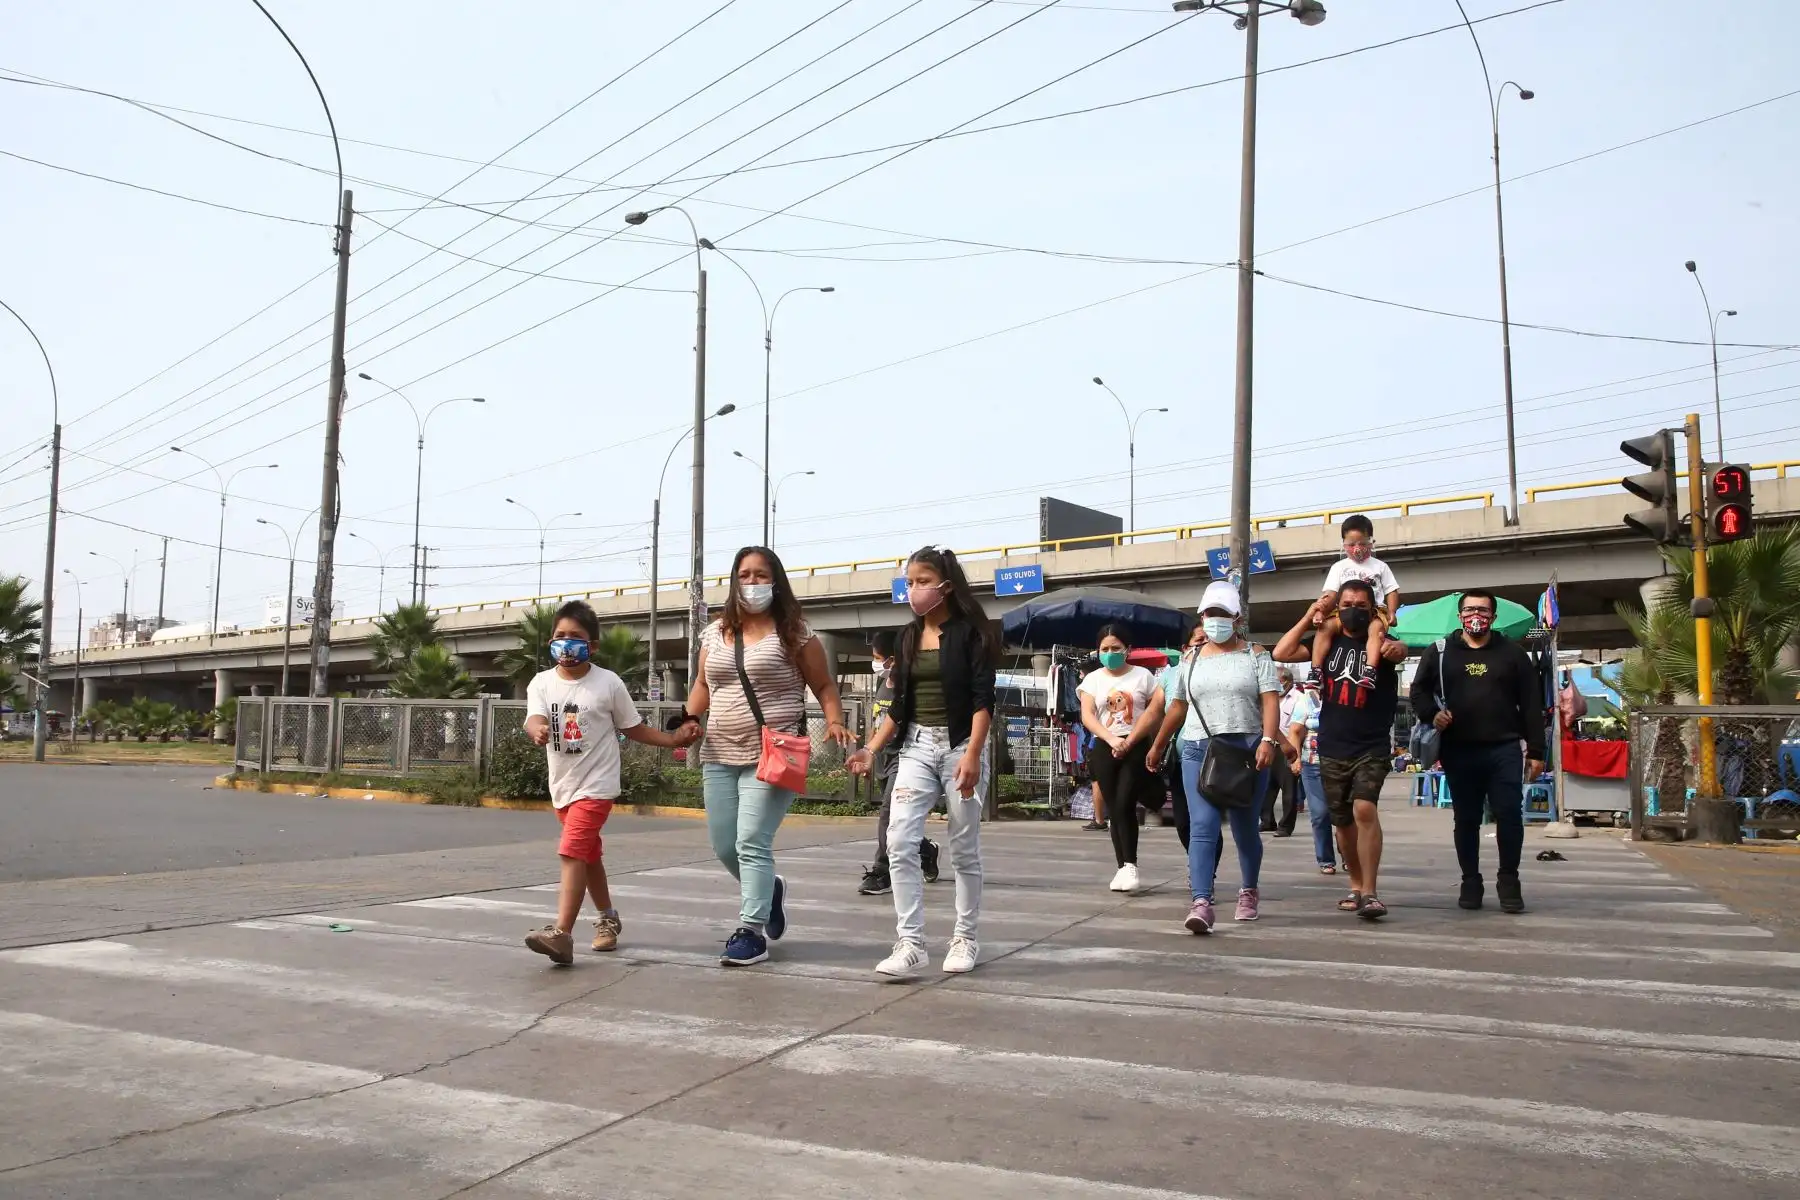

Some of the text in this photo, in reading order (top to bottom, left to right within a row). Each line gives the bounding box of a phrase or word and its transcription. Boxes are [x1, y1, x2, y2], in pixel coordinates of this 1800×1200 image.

[1716, 472, 1742, 493] 57
[1000, 569, 1036, 581] LOS OLIVOS
